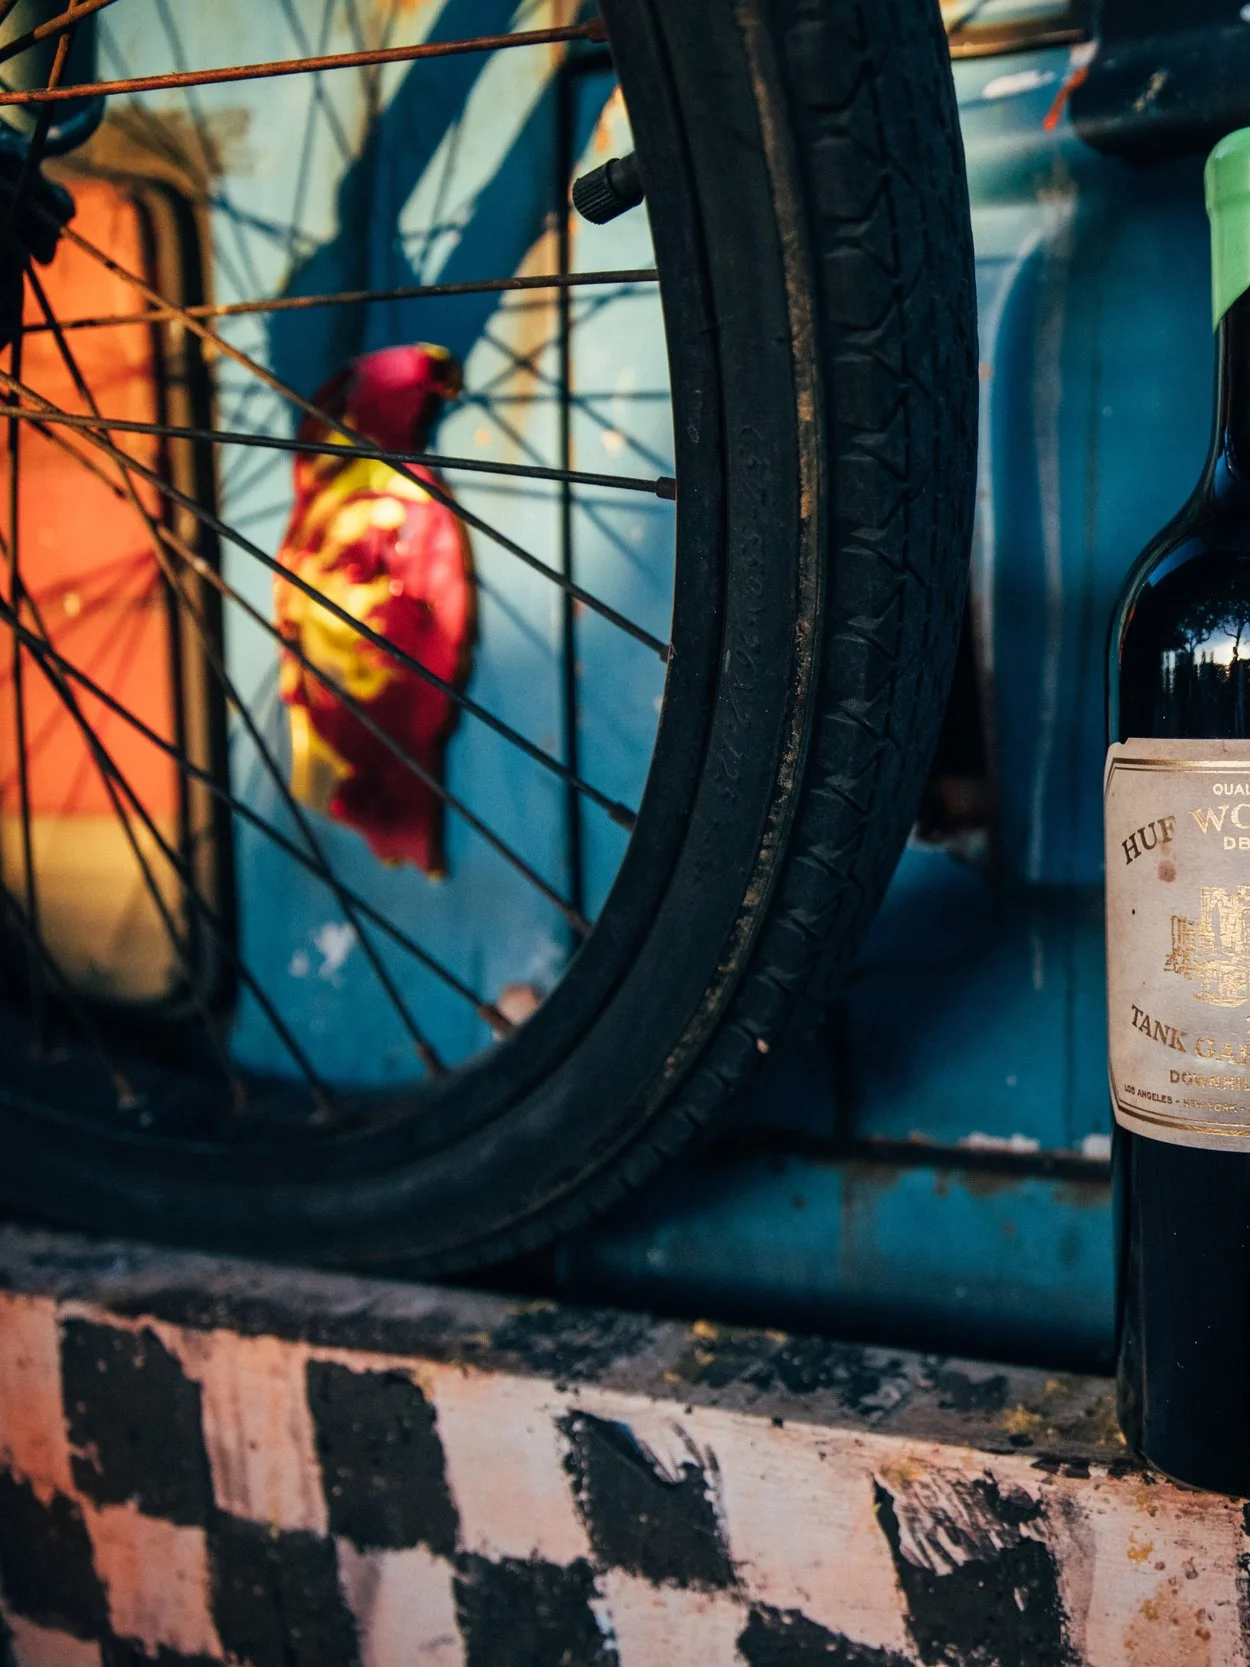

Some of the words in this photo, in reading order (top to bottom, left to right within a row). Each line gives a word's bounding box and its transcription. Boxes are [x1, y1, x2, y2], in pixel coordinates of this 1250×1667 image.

[1121, 814, 1177, 865] HUF
[1131, 1004, 1189, 1055] TANK
[1124, 1084, 1136, 1095] LOS
[1137, 1088, 1173, 1105] ANGELES
